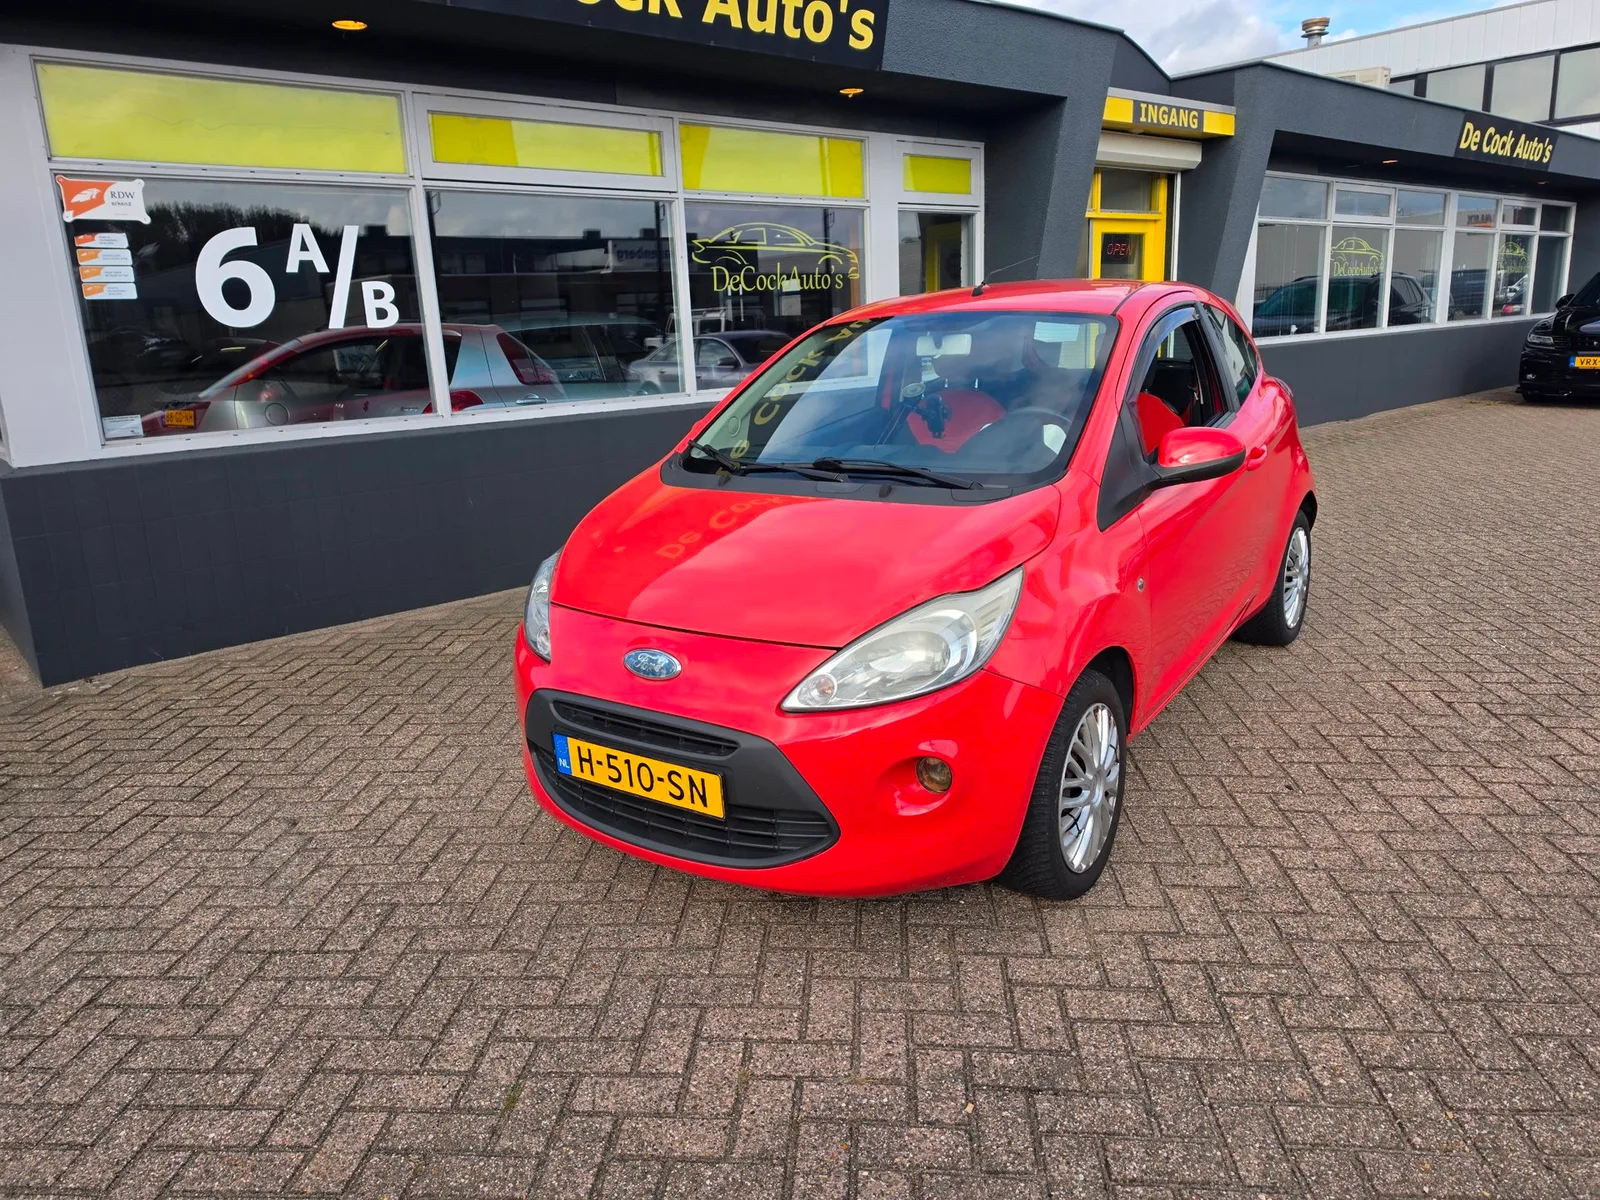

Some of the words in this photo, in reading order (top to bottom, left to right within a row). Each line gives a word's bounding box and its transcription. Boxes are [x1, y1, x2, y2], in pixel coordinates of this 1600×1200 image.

[701, 0, 876, 50] Auto's
[1139, 103, 1199, 129] INGANG
[1459, 122, 1481, 151] De
[1482, 126, 1515, 157] Cock
[1513, 133, 1553, 163] Auto's
[110, 191, 135, 199] RDW
[1107, 243, 1132, 256] OPEN
[711, 262, 844, 293] DeCockAuto's
[634, 653, 670, 674] Ford
[559, 757, 570, 769] NL
[577, 745, 708, 808] H-510-SN
